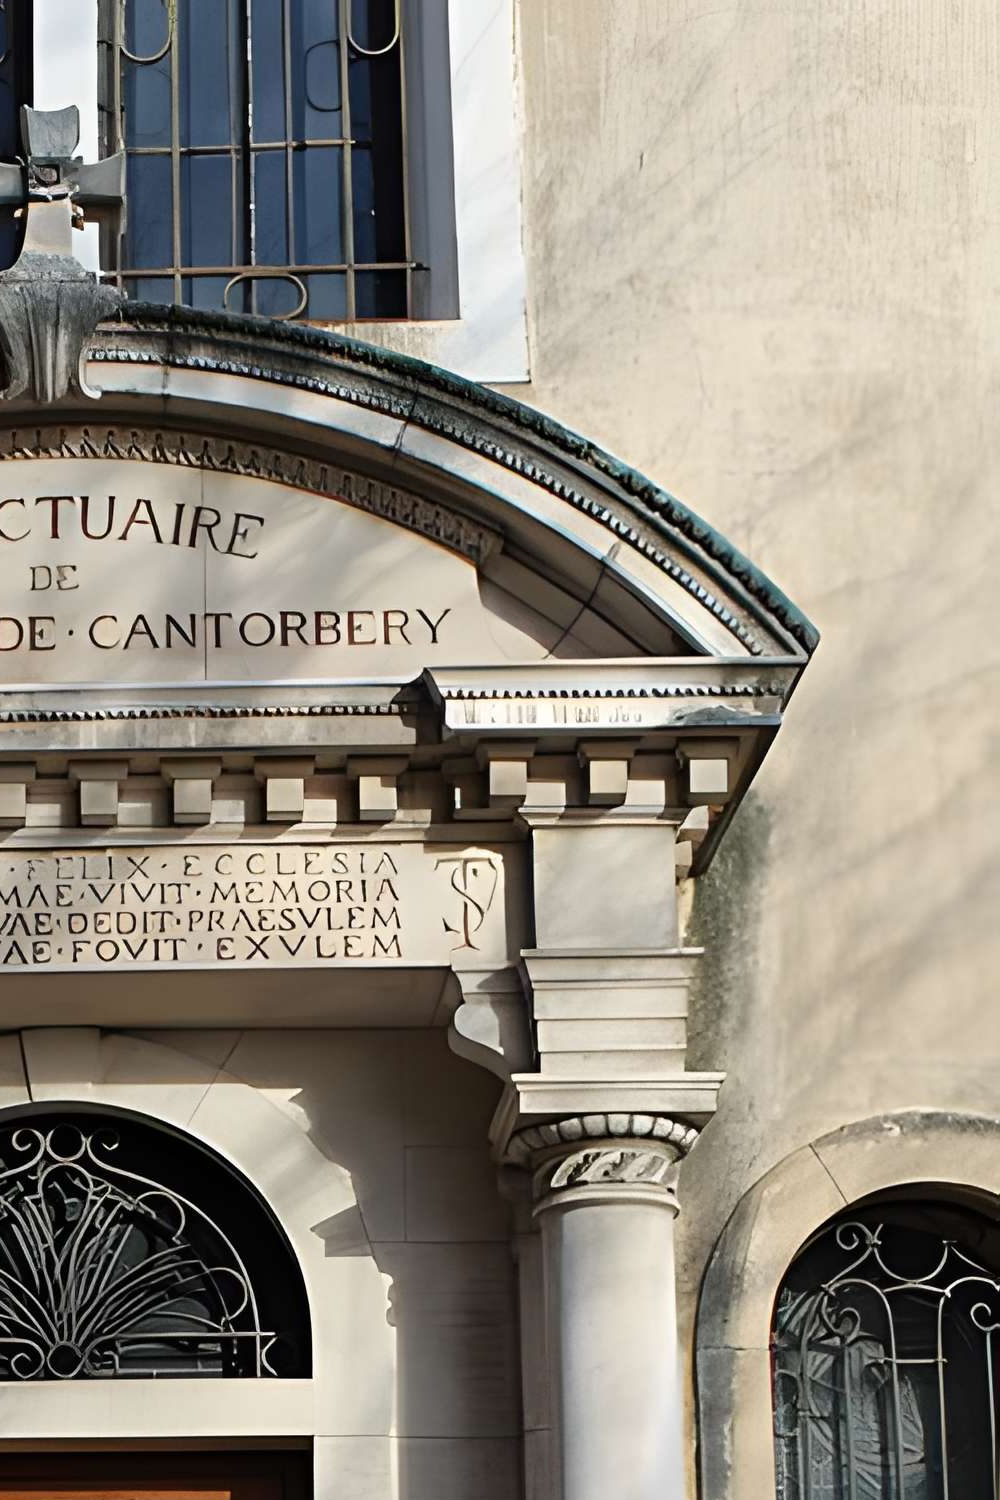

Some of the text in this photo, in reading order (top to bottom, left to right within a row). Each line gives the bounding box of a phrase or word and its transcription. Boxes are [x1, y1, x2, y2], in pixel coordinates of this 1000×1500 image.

[30, 565, 79, 591] DE
[88, 608, 452, 651] CANTORBERY
[183, 851, 398, 876] ECCLESIA
[88, 883, 191, 904] VIVIT
[210, 879, 399, 903] MEMORIA
[68, 911, 174, 935] DEDIT
[189, 907, 401, 931] PRAESVLEM
[72, 938, 187, 962] FOVIT
[216, 934, 402, 960] EXVLEM
